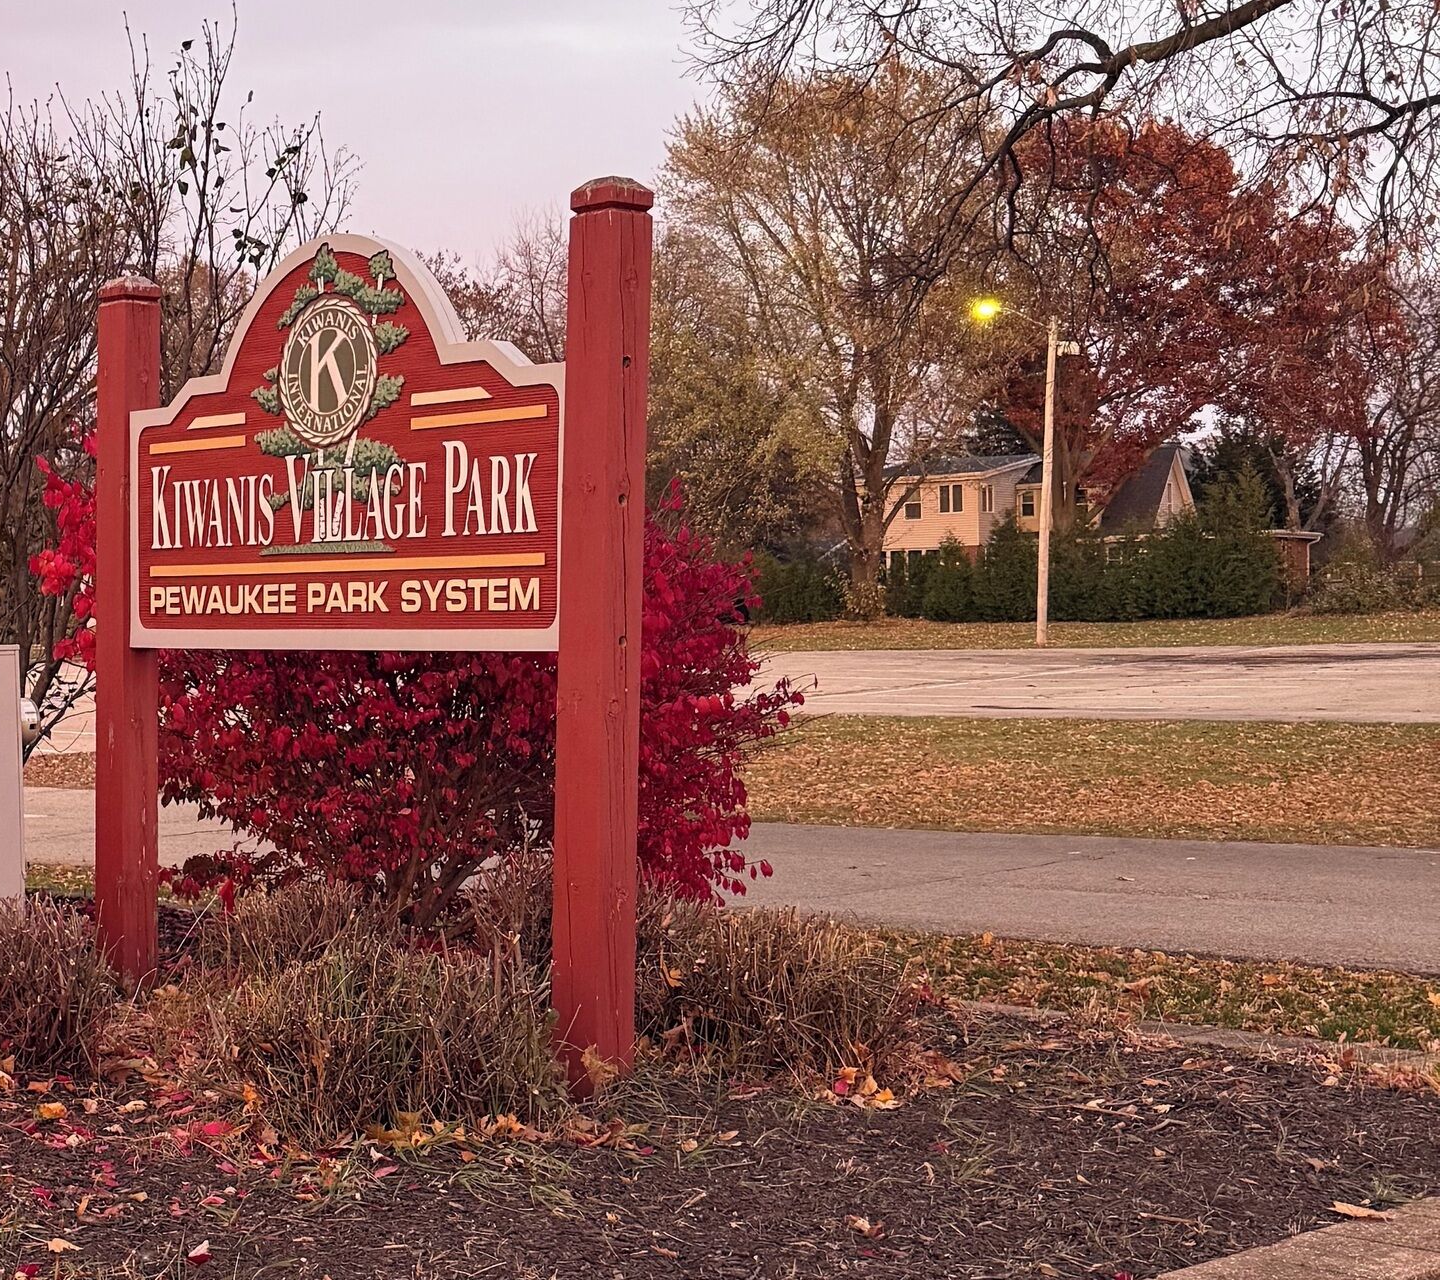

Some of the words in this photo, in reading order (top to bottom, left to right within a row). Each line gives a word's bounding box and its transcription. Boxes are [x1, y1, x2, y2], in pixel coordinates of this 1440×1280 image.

[296, 310, 360, 348] KIWANIS
[288, 363, 368, 433] INTERNATIONAL
[307, 330, 349, 412] K
[150, 465, 275, 550] KIWANIS
[284, 452, 428, 543] VILLAGE
[441, 440, 540, 538] PARK
[149, 583, 297, 615] PEWAUKEE
[307, 580, 390, 614] PARK
[400, 576, 540, 613] SYSTEM
